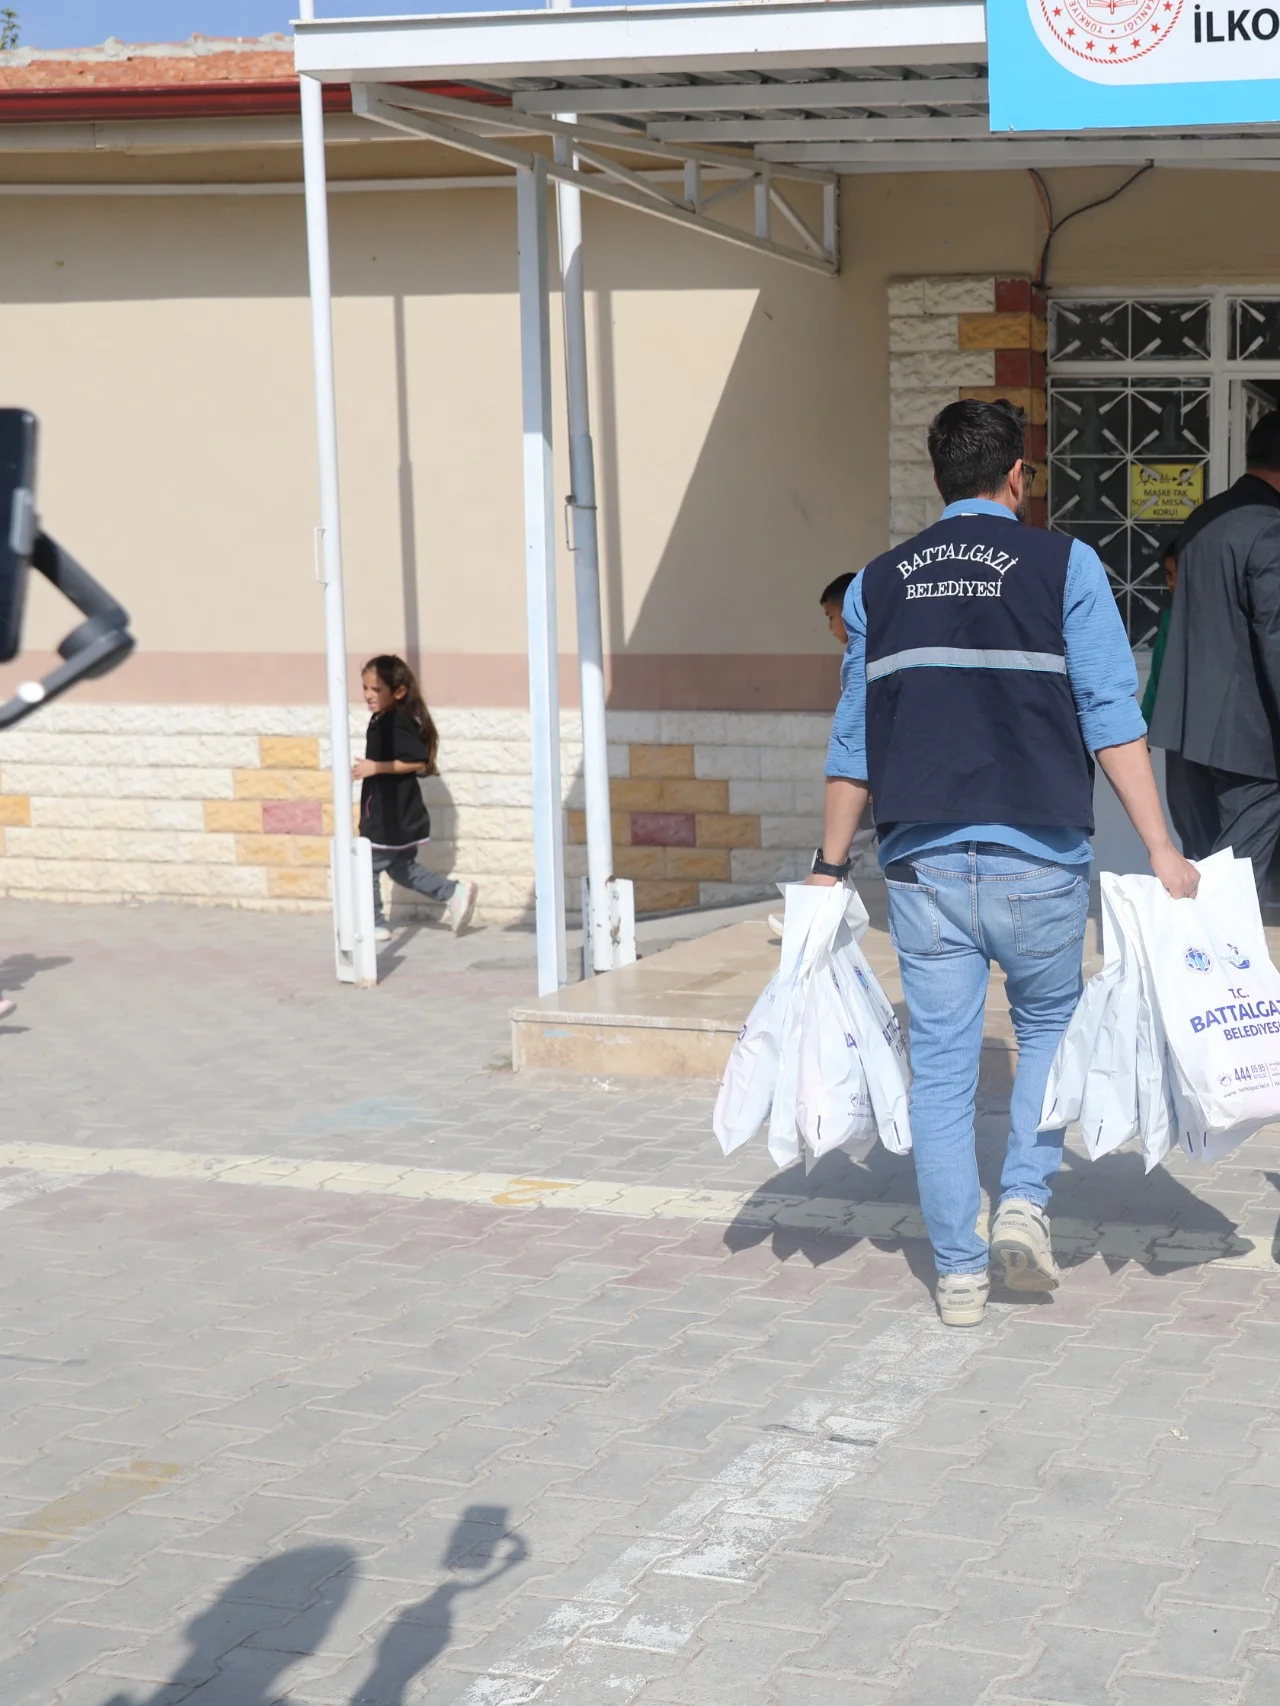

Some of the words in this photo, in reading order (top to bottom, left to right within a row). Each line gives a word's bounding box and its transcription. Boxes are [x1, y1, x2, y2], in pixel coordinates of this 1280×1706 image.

[1144, 489, 1171, 497] MASKE
[1173, 489, 1188, 497] TAK
[896, 543, 1019, 579] BATTALGAZİ
[906, 577, 1003, 600] BELEDİYESİ
[1228, 988, 1250, 999] T.C.
[1234, 1066, 1252, 1082] 444
